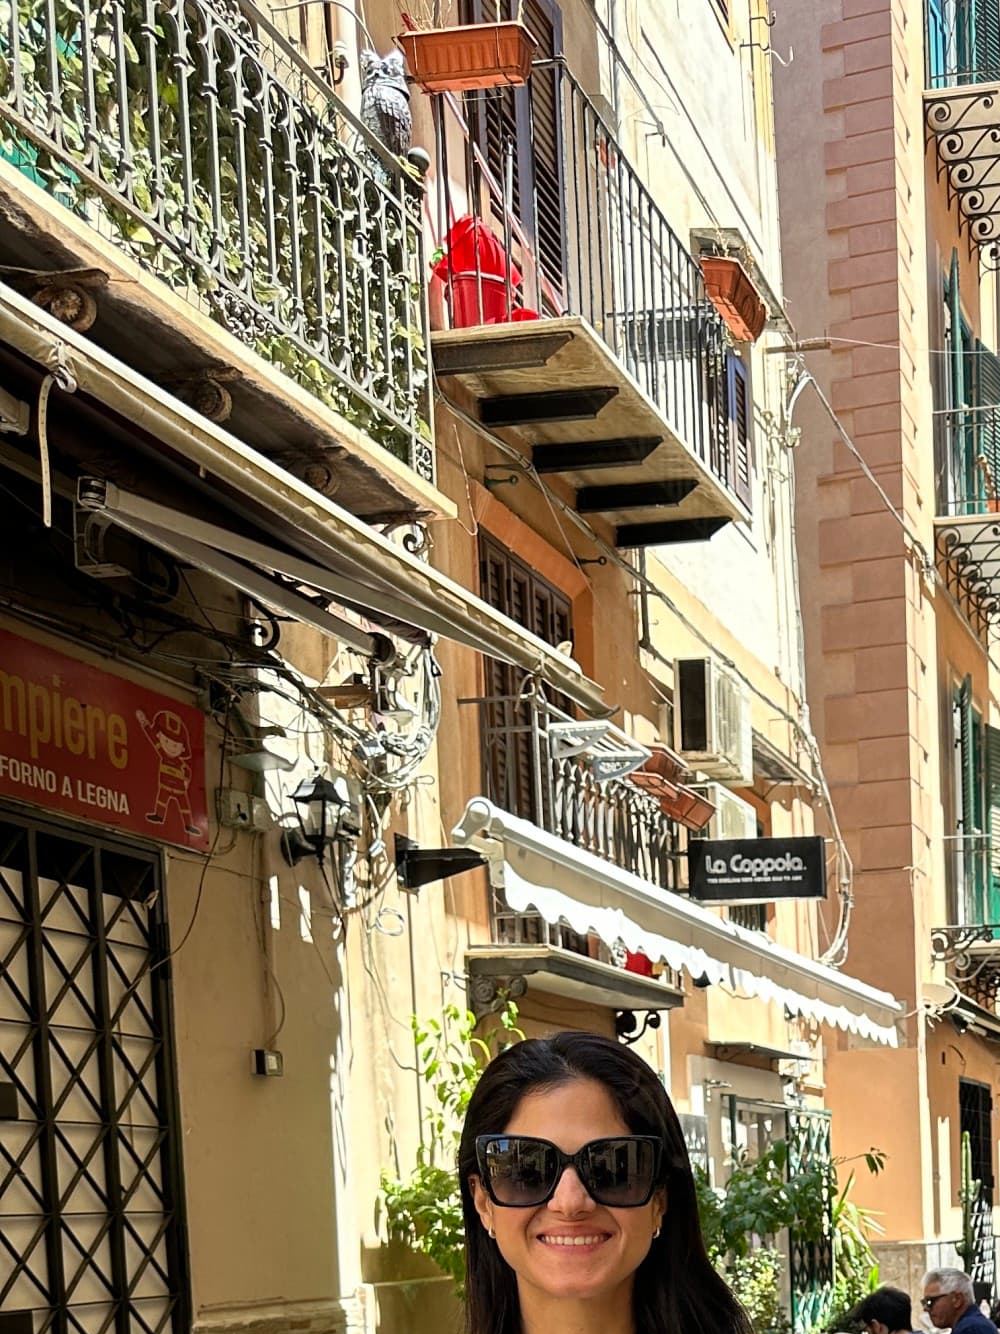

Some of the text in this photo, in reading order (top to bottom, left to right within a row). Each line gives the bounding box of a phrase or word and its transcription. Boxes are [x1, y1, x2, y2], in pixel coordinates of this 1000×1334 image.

[0, 755, 130, 815] FORNO A LEGNA
[705, 855, 727, 874] La
